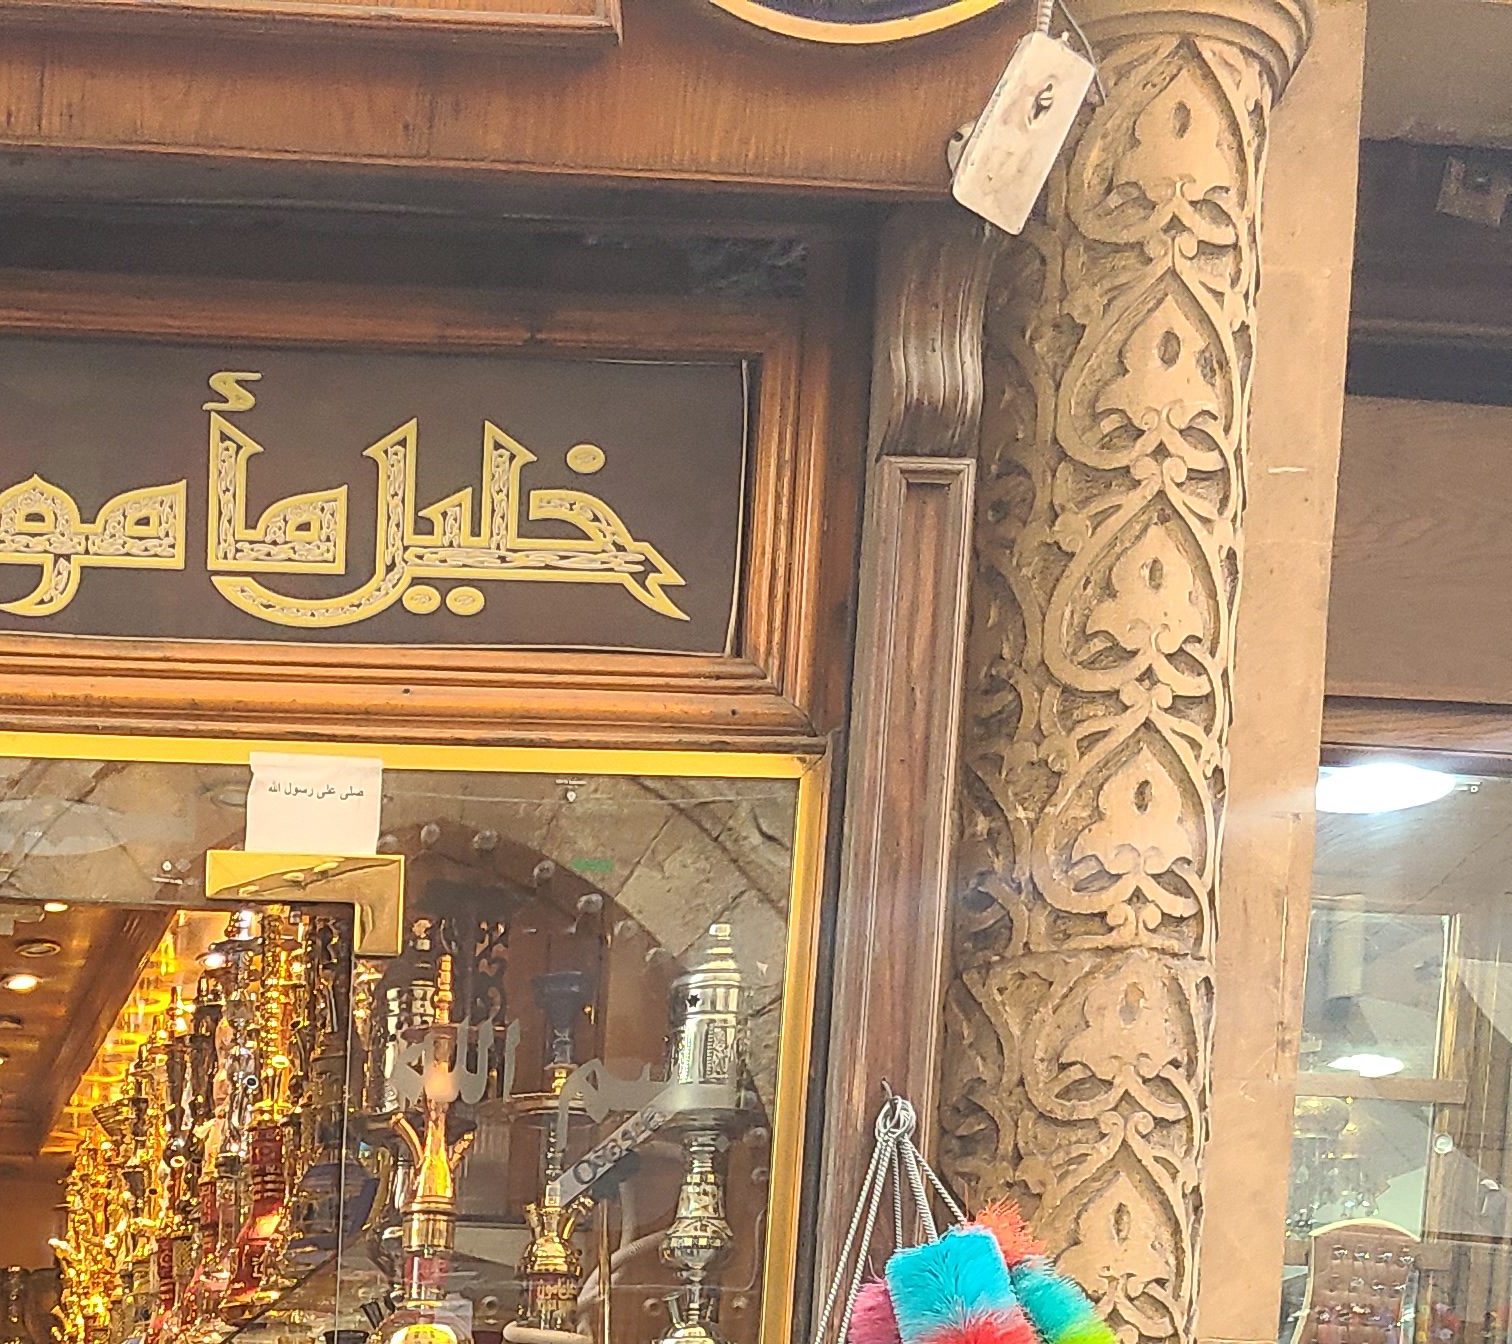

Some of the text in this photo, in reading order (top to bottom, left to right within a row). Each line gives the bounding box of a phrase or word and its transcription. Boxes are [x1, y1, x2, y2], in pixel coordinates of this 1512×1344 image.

[210, 417, 690, 628] خليل
[268, 781, 281, 792] الله
[284, 782, 314, 797] رسول
[389, 1012, 520, 1112] الله
